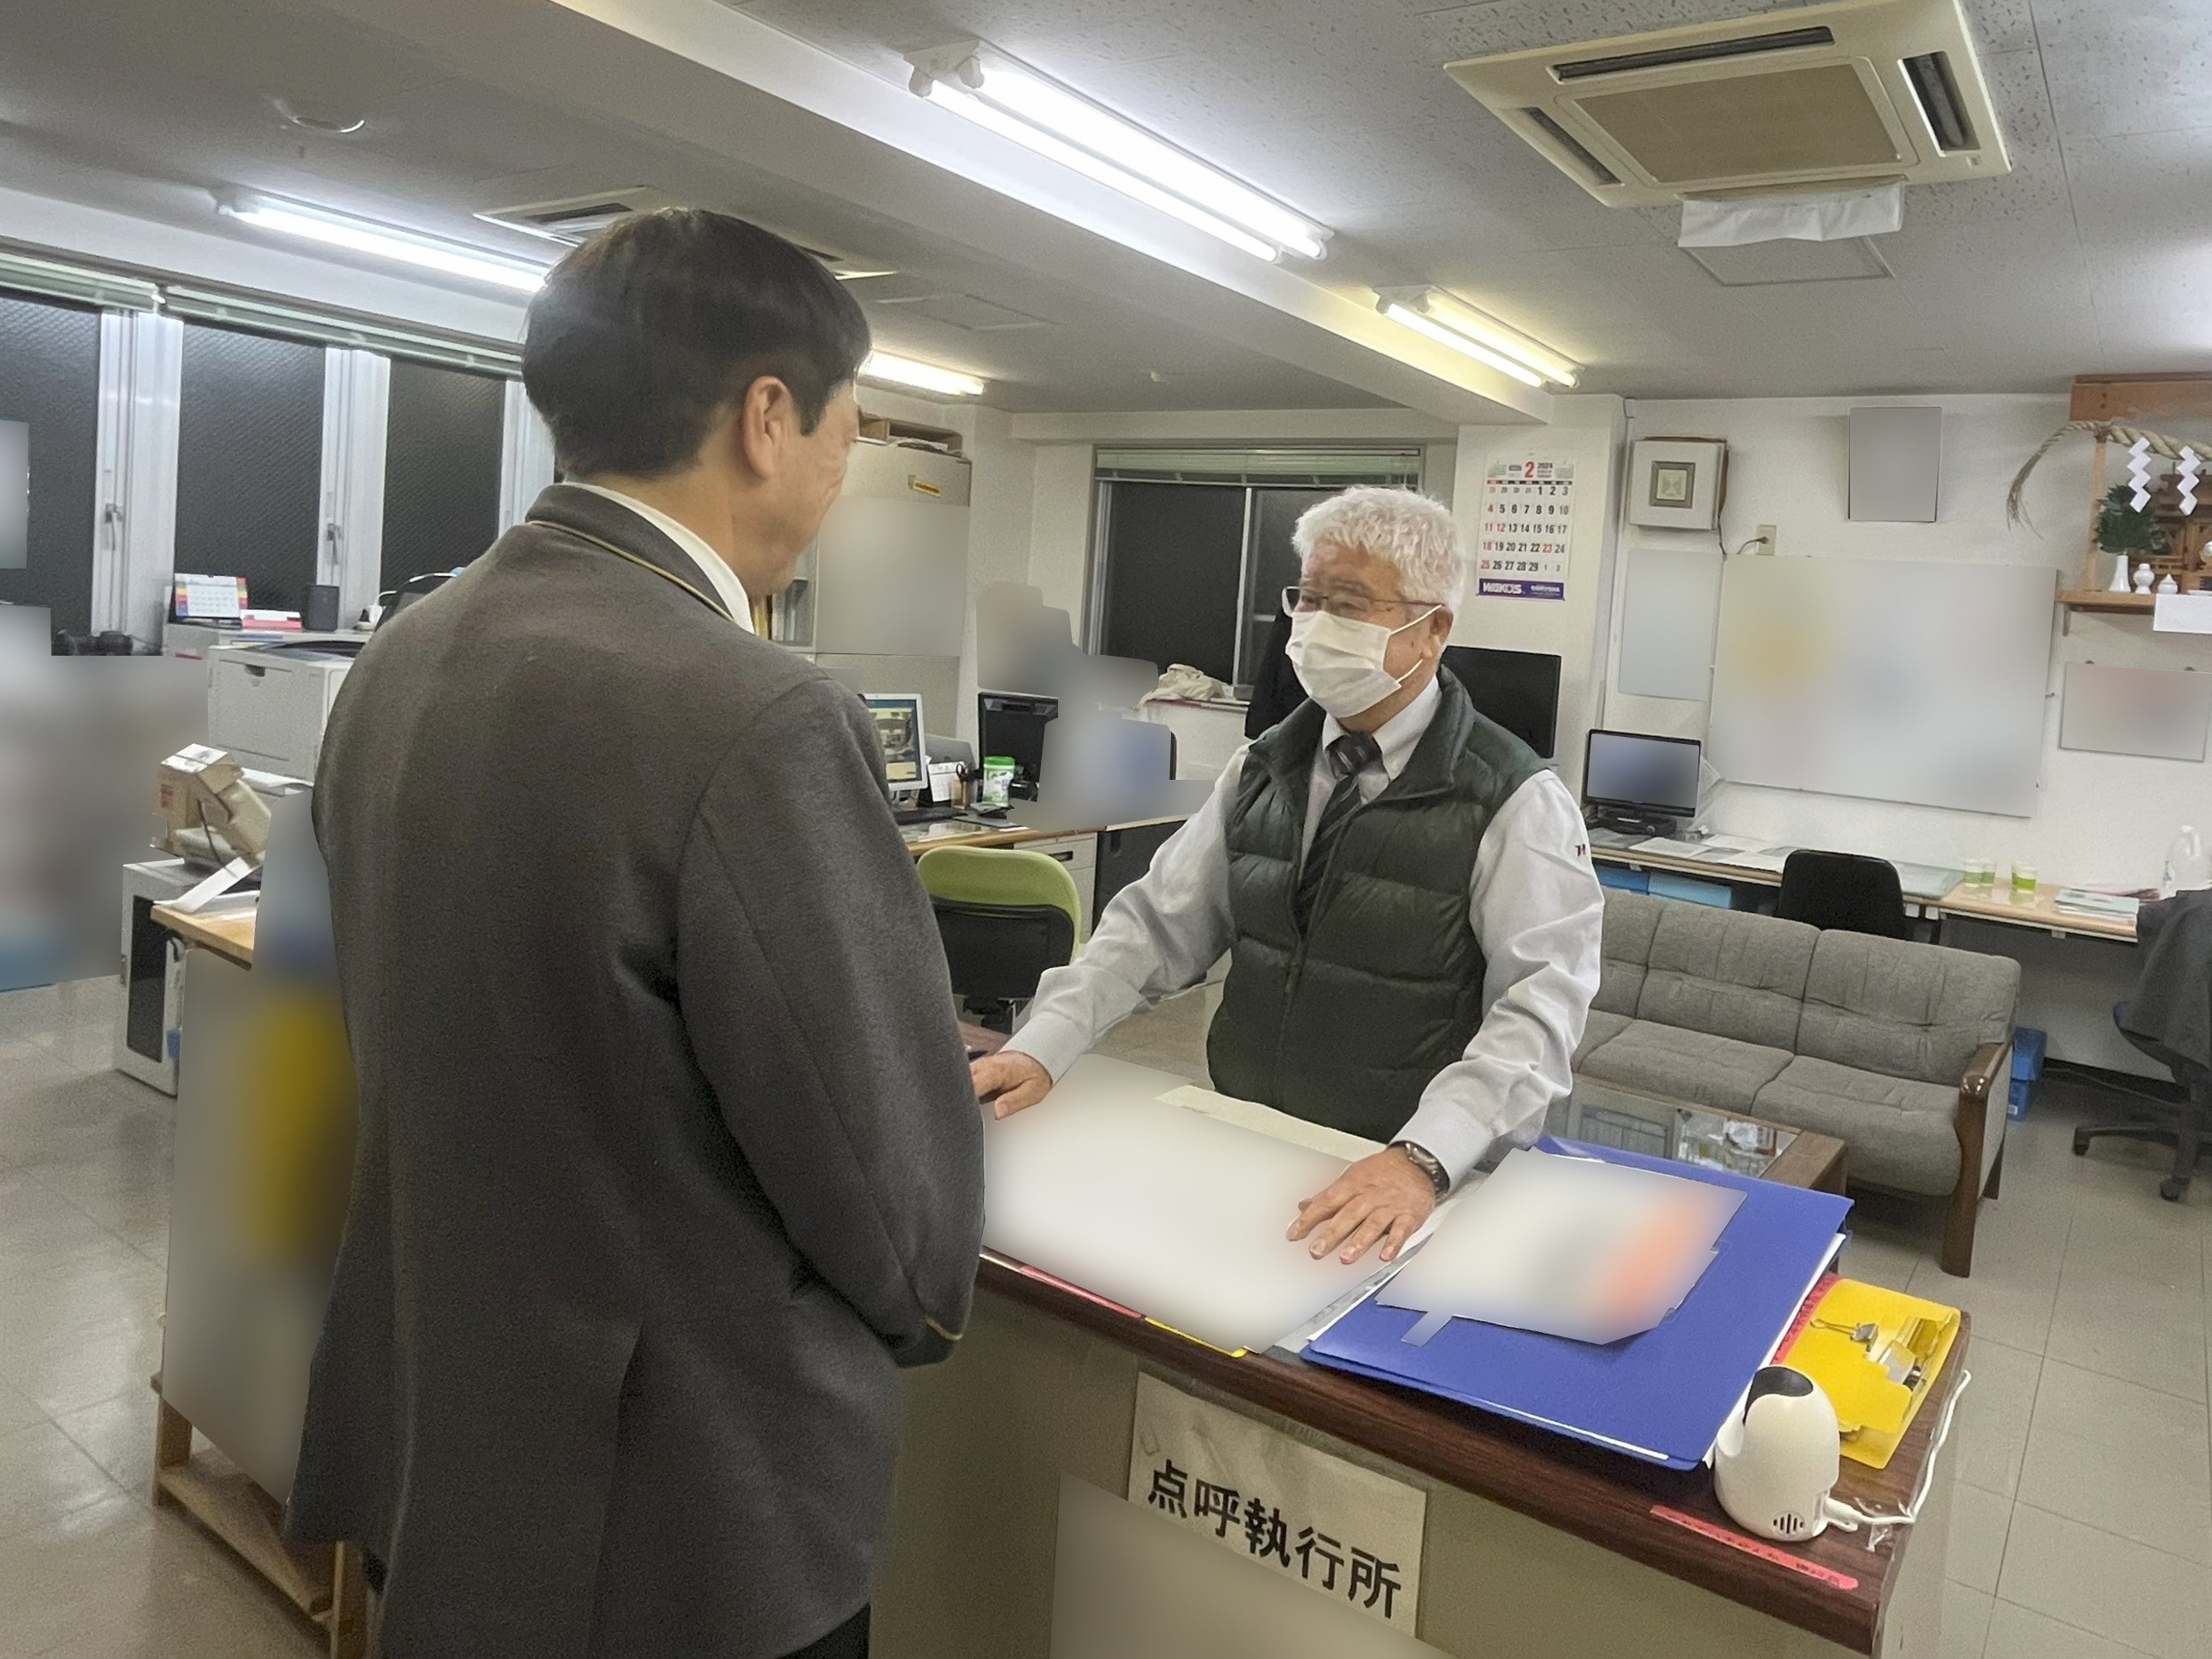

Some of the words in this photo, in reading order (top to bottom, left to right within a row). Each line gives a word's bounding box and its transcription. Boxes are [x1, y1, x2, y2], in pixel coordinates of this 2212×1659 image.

[1525, 461, 1534, 478] 2
[1538, 487, 1542, 495] 1
[1550, 487, 1556, 495] 2
[1562, 487, 1568, 495] 3
[1500, 504, 1505, 513] 5
[1512, 504, 1517, 513] 6
[1524, 505, 1530, 514] 7
[1536, 505, 1542, 514] 8
[1548, 506, 1554, 514] 9
[1559, 506, 1569, 515] 10
[1485, 523, 1493, 531] 11
[1497, 523, 1505, 532] 12
[1509, 524, 1517, 533] 13
[1521, 524, 1529, 533] 14
[1533, 525, 1542, 533] 15
[1545, 525, 1554, 534] 16
[1558, 525, 1567, 534] 17
[1483, 542, 1492, 550] 18
[1495, 542, 1504, 551] 19
[1506, 543, 1515, 551] 20
[1518, 543, 1527, 552] 21
[1531, 543, 1540, 552] 22
[1542, 544, 1552, 553] 23
[1555, 544, 1565, 553] 24
[1481, 560, 1490, 569] 25
[1493, 561, 1501, 570] 26
[1505, 561, 1514, 570] 27
[1517, 562, 1526, 571] 28
[1529, 562, 1538, 571] 29
[1148, 1460, 1401, 1619] 点呼執行所
